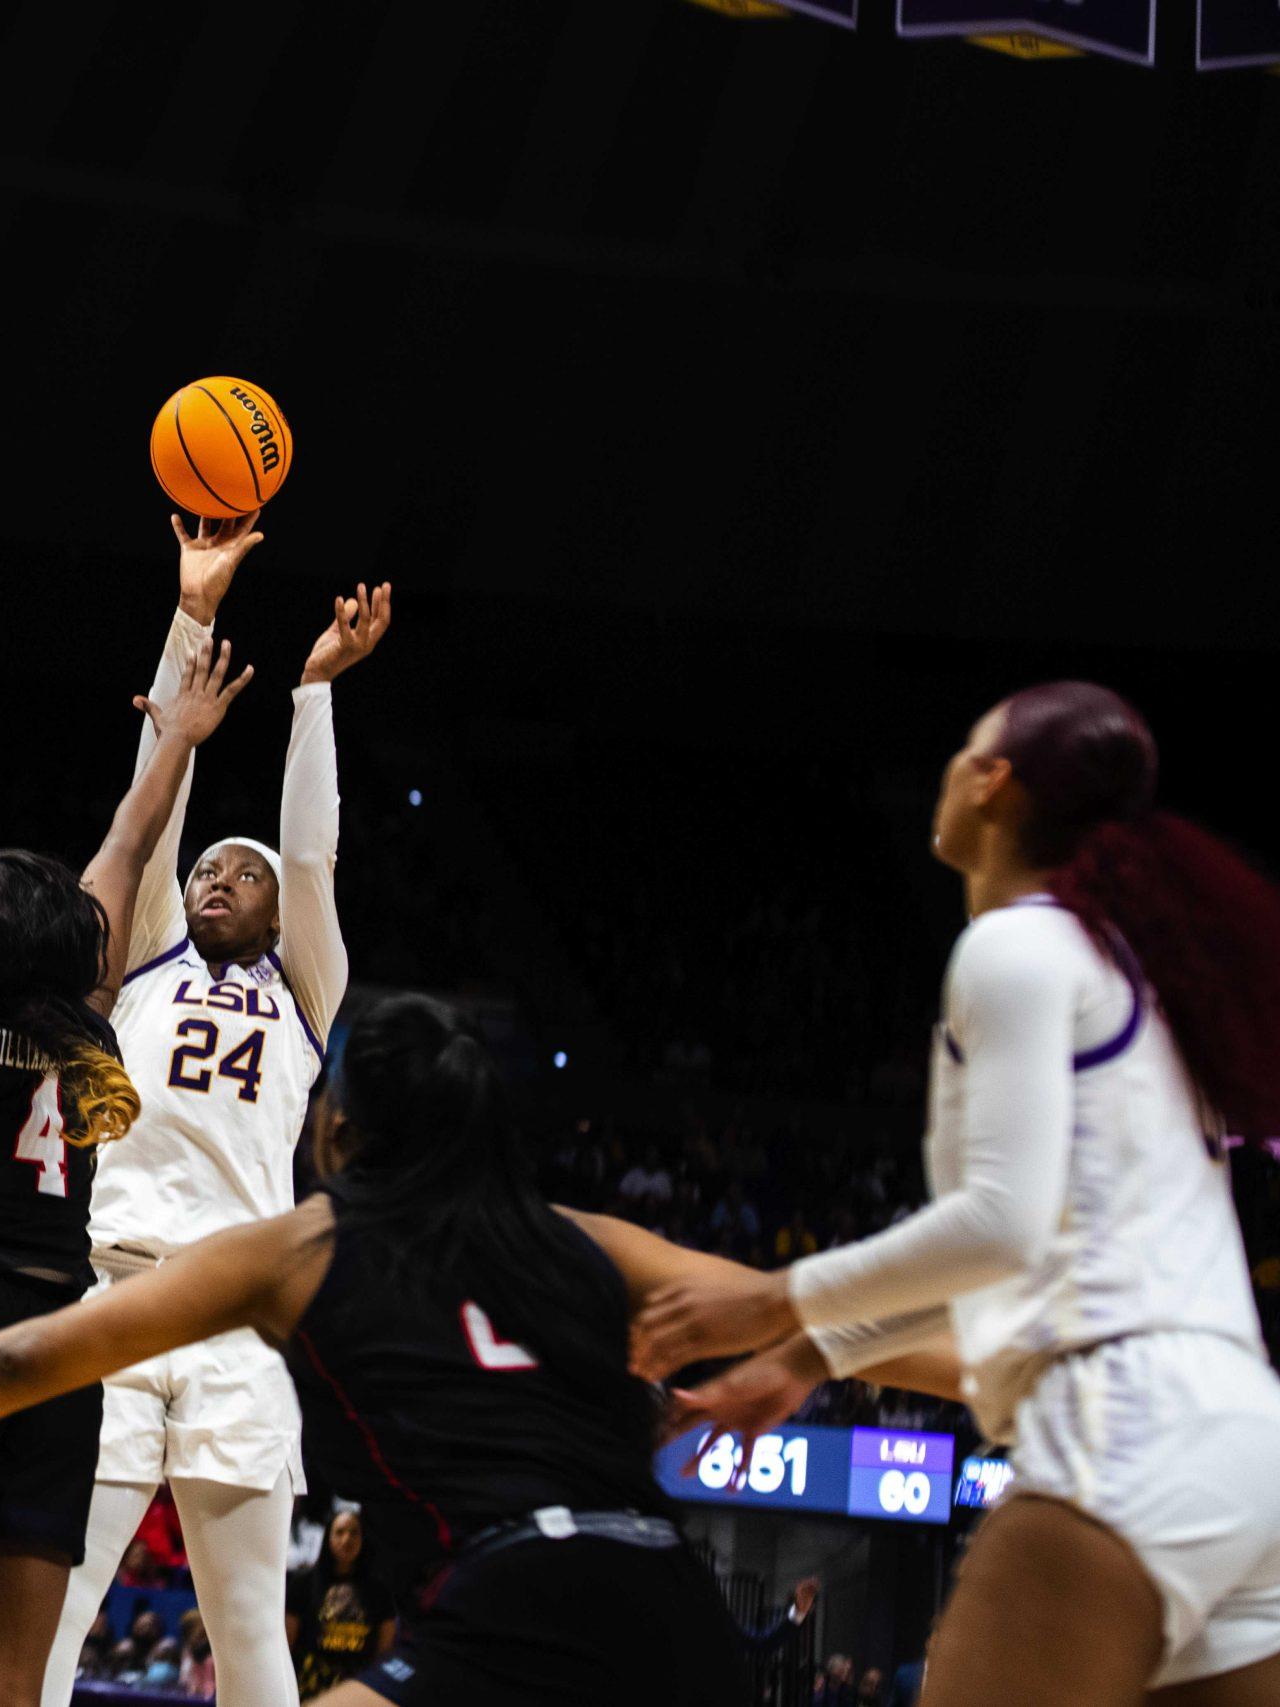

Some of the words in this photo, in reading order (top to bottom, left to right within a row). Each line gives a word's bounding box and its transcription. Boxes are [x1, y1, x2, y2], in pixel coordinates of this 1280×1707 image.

[230, 386, 280, 474] Wilson
[172, 980, 280, 1020] LSU
[168, 1018, 266, 1103] 24
[11, 1066, 69, 1201] 4
[878, 1468, 930, 1514] 60
